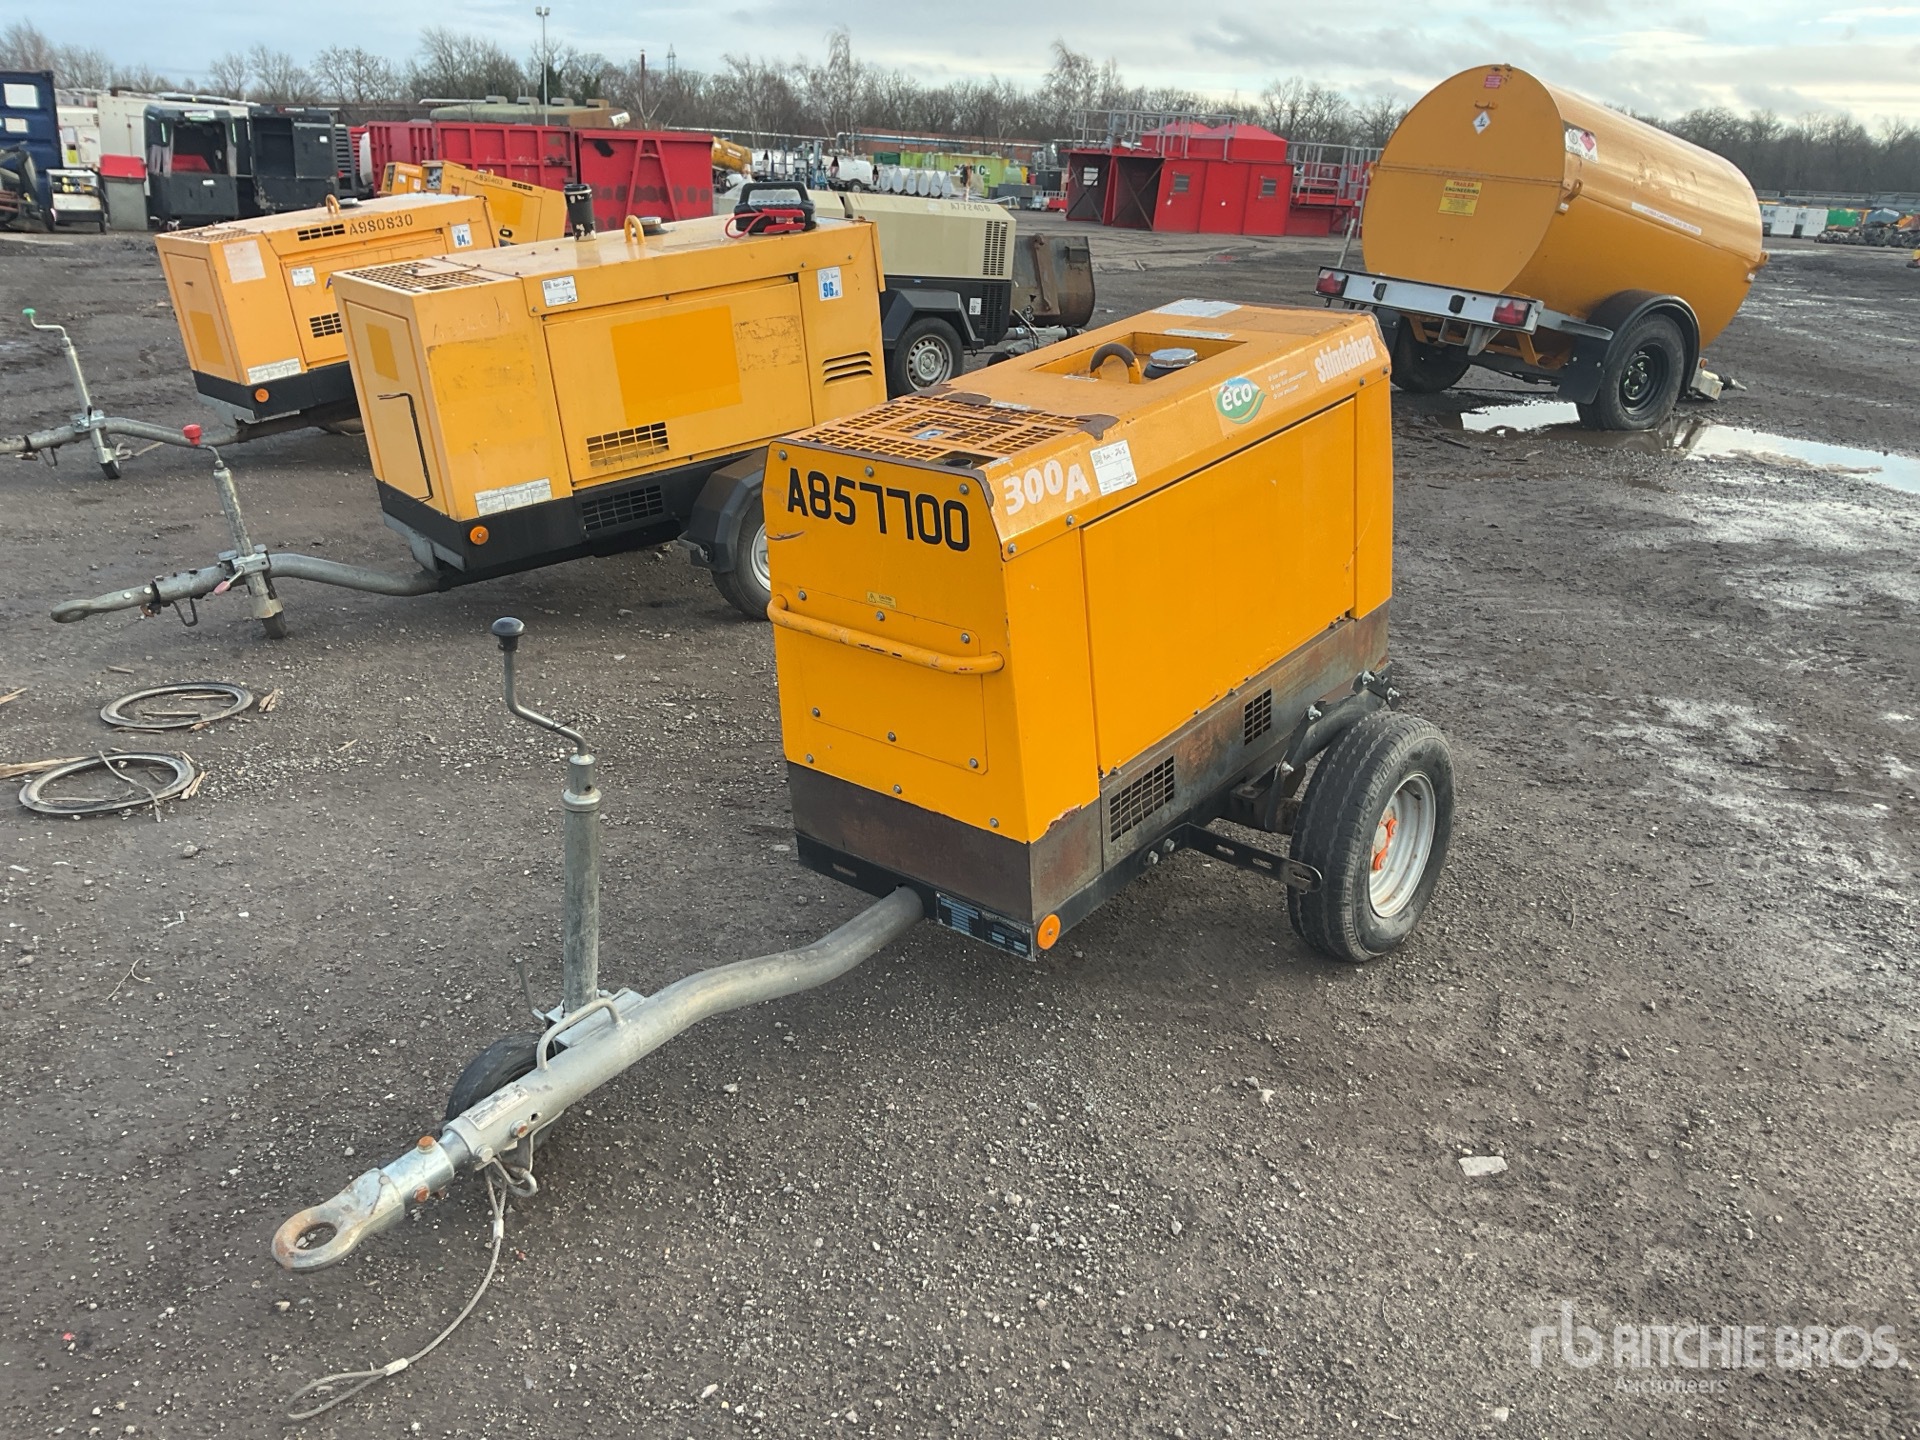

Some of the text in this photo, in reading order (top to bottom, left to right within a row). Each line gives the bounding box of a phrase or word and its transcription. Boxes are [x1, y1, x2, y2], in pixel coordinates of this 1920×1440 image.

[349, 213, 413, 236] A980830
[822, 281, 834, 298] 96
[1314, 335, 1378, 383] shindaiwa
[787, 467, 970, 552] A857700
[1003, 459, 1091, 516] 300A
